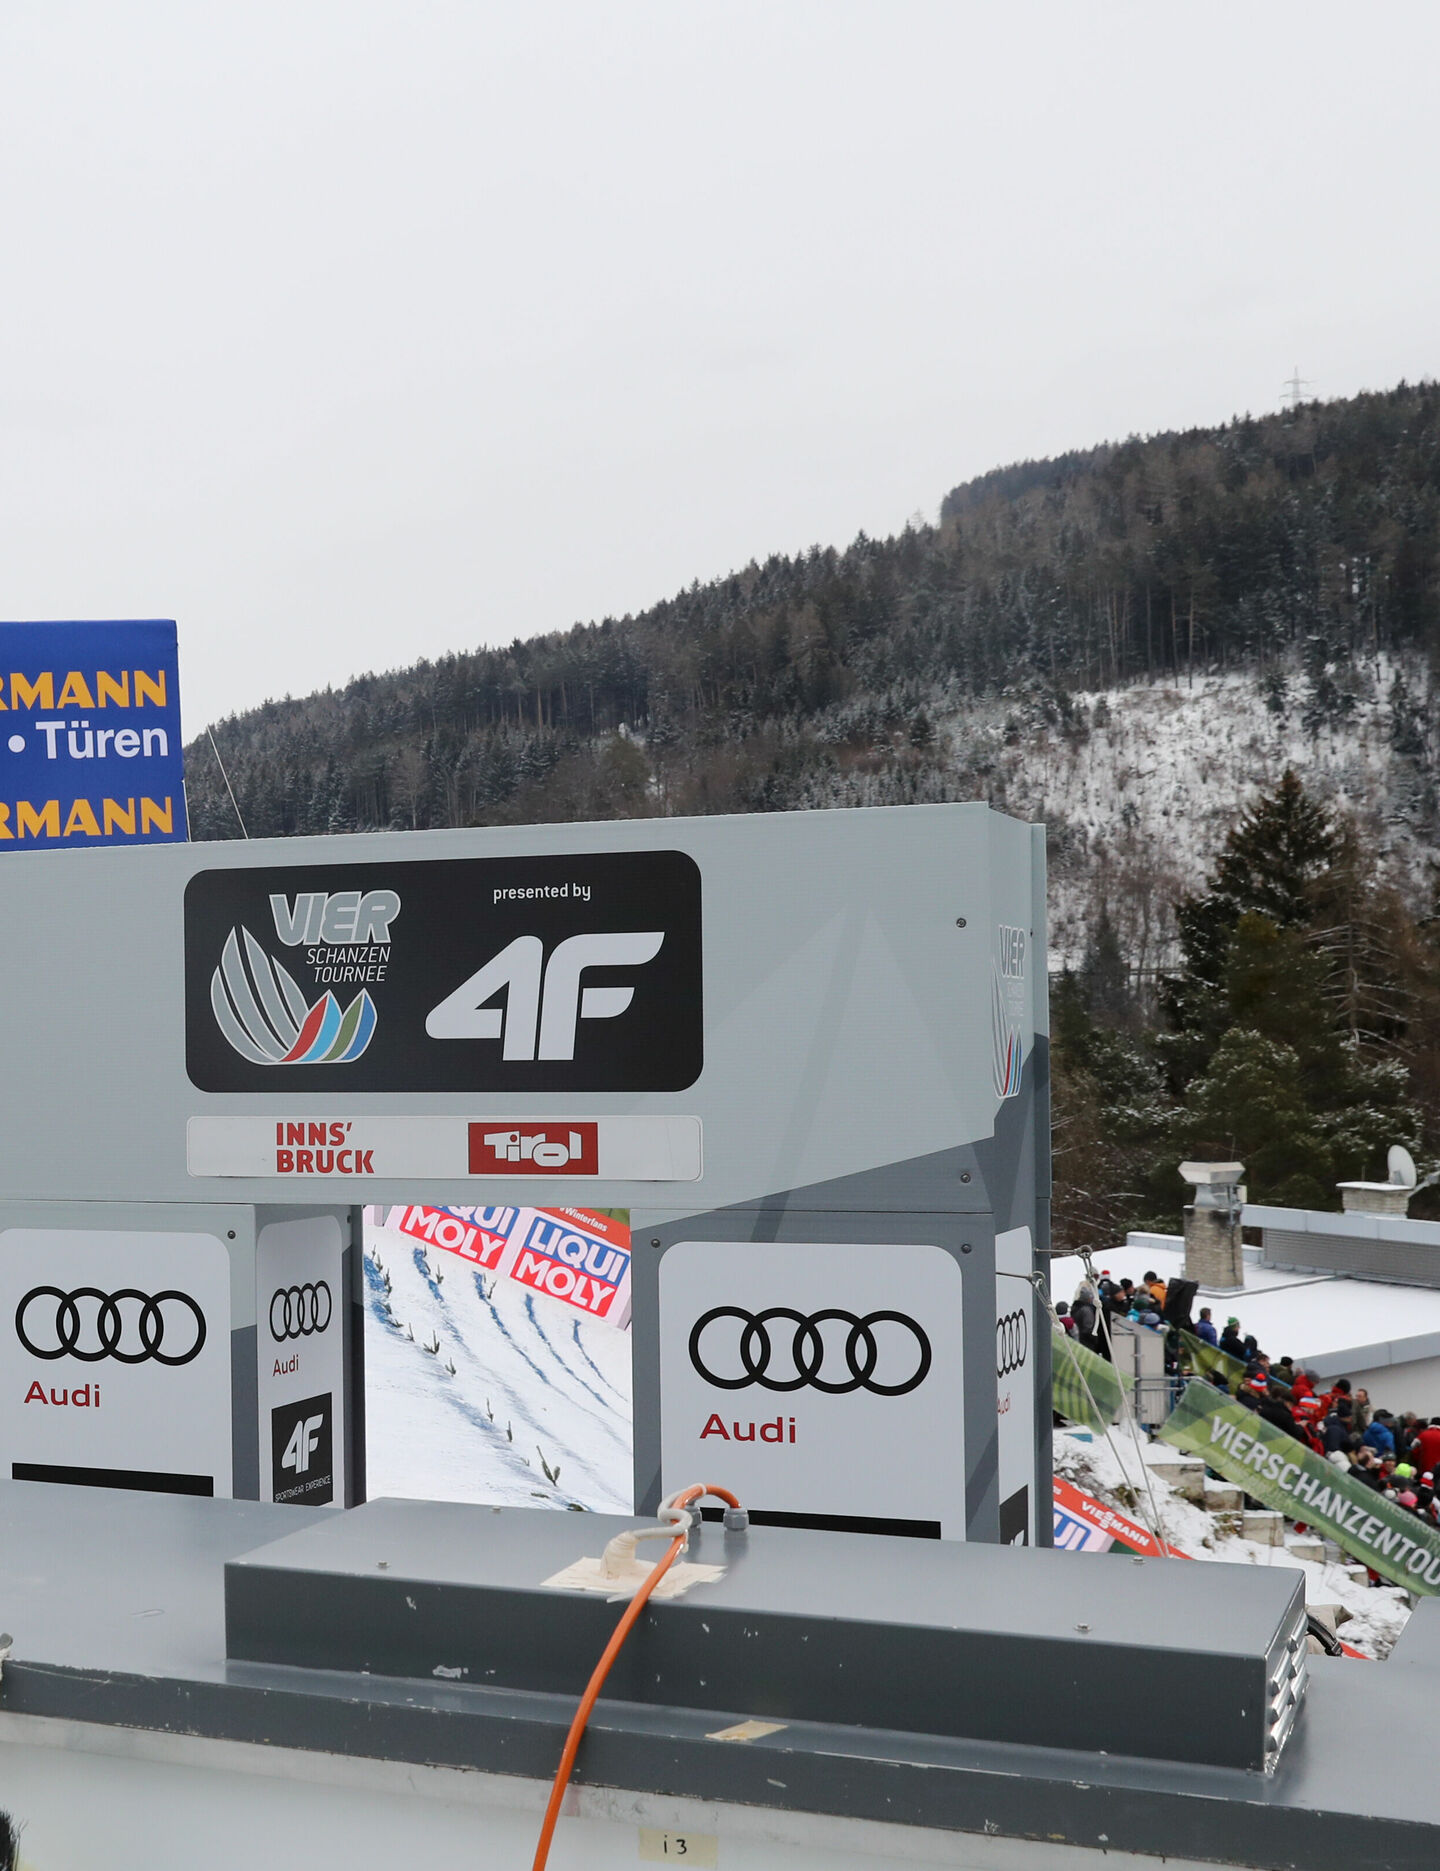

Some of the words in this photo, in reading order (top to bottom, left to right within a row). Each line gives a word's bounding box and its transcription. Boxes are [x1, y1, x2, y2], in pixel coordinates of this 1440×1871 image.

[35, 719, 169, 760] Türen
[493, 884, 569, 904] presented
[572, 882, 591, 902] by
[268, 889, 401, 947] VIER
[306, 945, 391, 966] SCHANZEN
[314, 965, 387, 984] TOURNEE
[425, 931, 665, 1061] 4F
[275, 1149, 374, 1174] BRUCK
[483, 1129, 582, 1168] Tirol
[405, 1205, 506, 1264] MOLY
[528, 1218, 628, 1283] LIQUI
[515, 1251, 616, 1312] MOLY
[272, 1353, 299, 1377] Audi
[23, 1380, 101, 1408] Audi
[281, 1413, 324, 1475] 4F
[699, 1413, 796, 1444] Audi
[274, 1483, 305, 1503] SPORTSWEAR
[305, 1474, 332, 1492] EXPERIENCE
